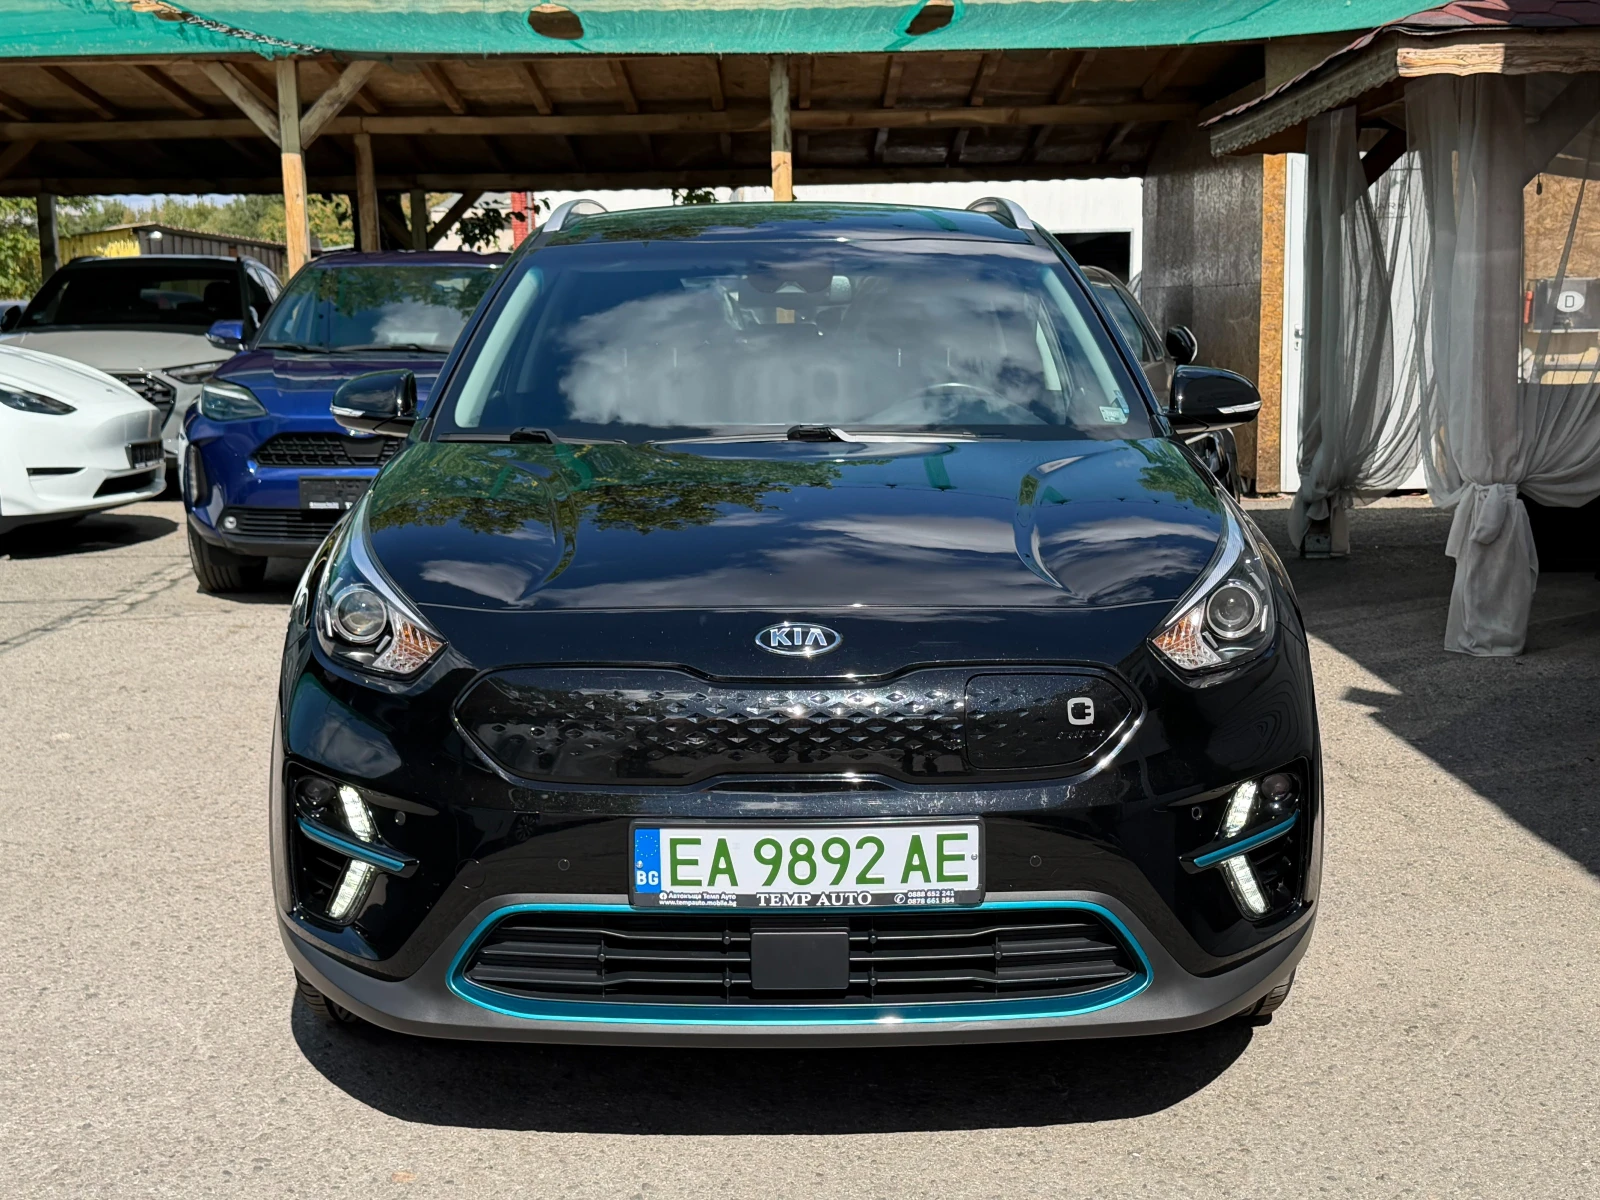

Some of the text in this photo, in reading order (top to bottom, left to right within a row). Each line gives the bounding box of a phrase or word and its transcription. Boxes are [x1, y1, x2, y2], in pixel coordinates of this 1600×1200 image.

[770, 627, 828, 646] KIA
[669, 832, 969, 887] EA 9892 AE
[636, 870, 659, 886] BG
[702, 892, 720, 900] Темп
[720, 892, 737, 901] Ауто
[756, 892, 873, 906] TEMP AUTO
